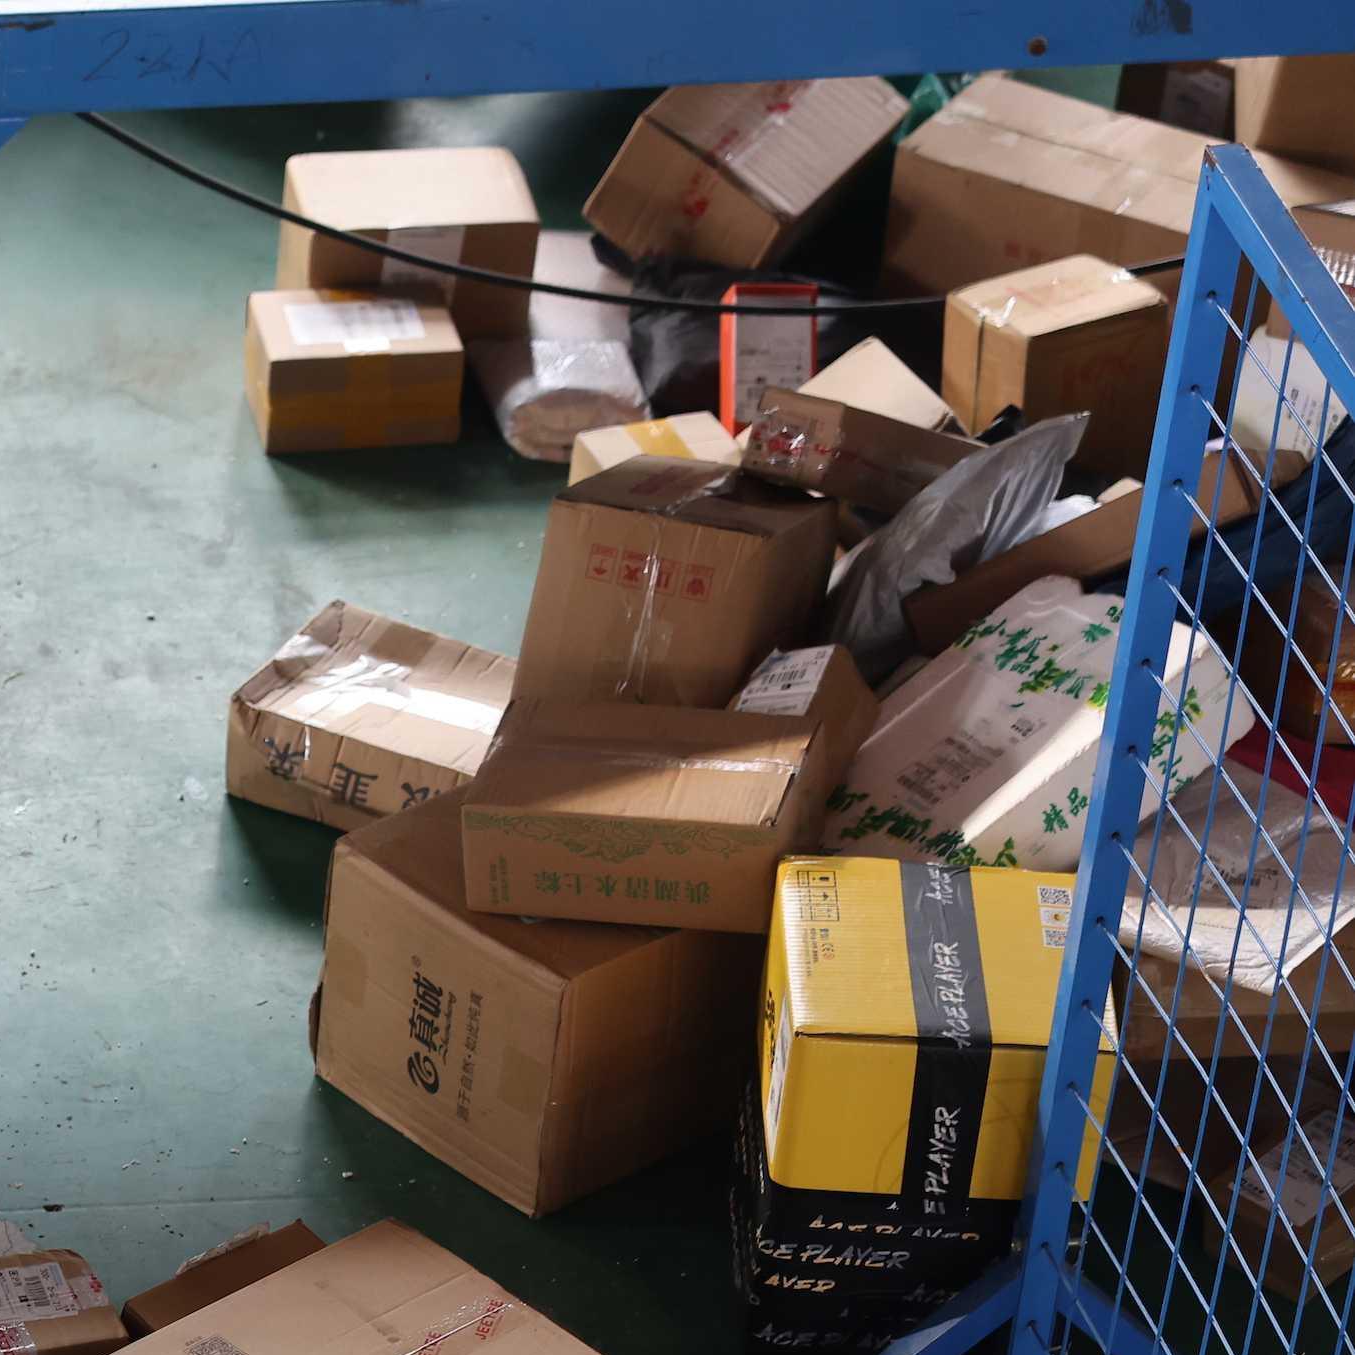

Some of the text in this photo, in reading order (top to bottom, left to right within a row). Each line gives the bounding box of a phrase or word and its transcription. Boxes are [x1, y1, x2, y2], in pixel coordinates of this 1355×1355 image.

[925, 1106, 963, 1194] PLAYER
[799, 1241, 911, 1273] PLAYER
[474, 1298, 506, 1341] JEETEE
